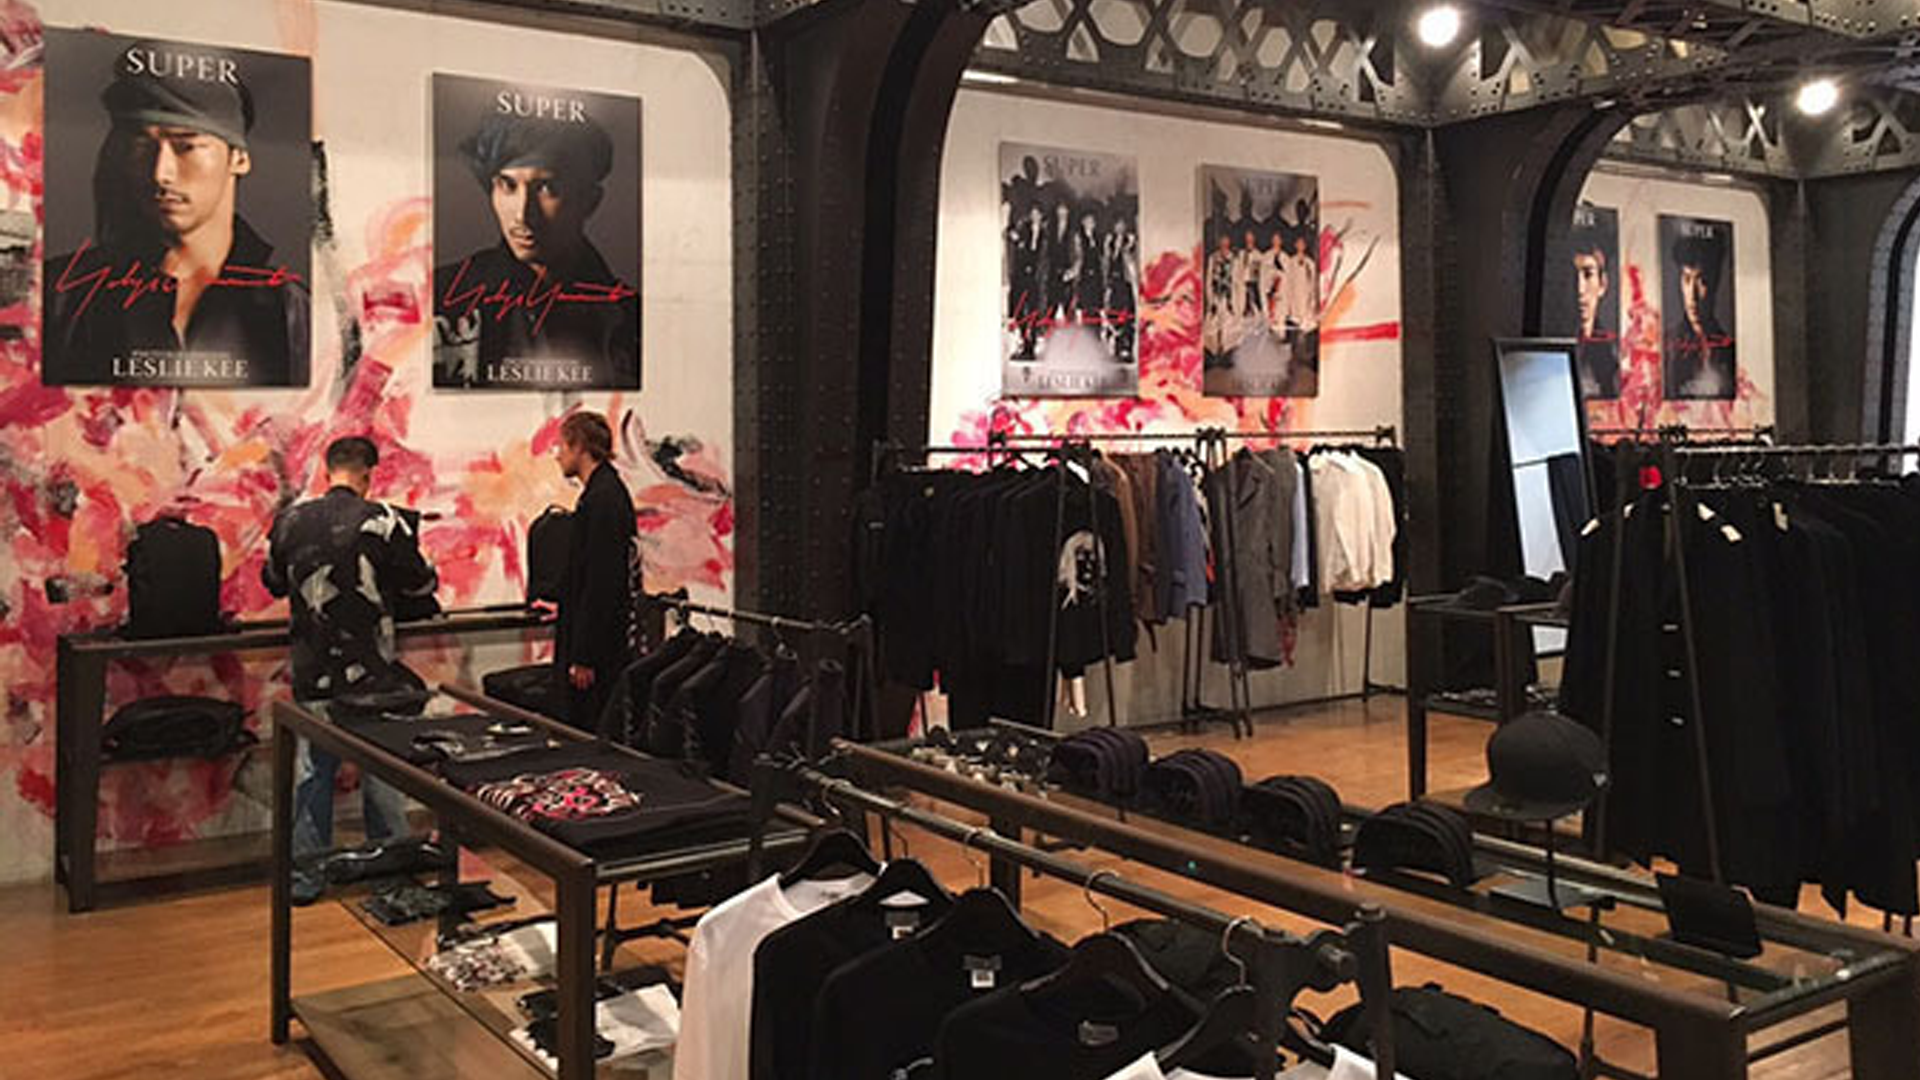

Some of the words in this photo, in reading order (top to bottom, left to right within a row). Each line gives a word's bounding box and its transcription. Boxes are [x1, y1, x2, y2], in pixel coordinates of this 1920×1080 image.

[126, 48, 239, 85] SUPER
[496, 92, 587, 123] SUPER
[113, 357, 197, 378] LESLIE
[203, 359, 248, 379] KEE
[487, 364, 554, 382] LESLIE
[557, 365, 593, 383] KEE
